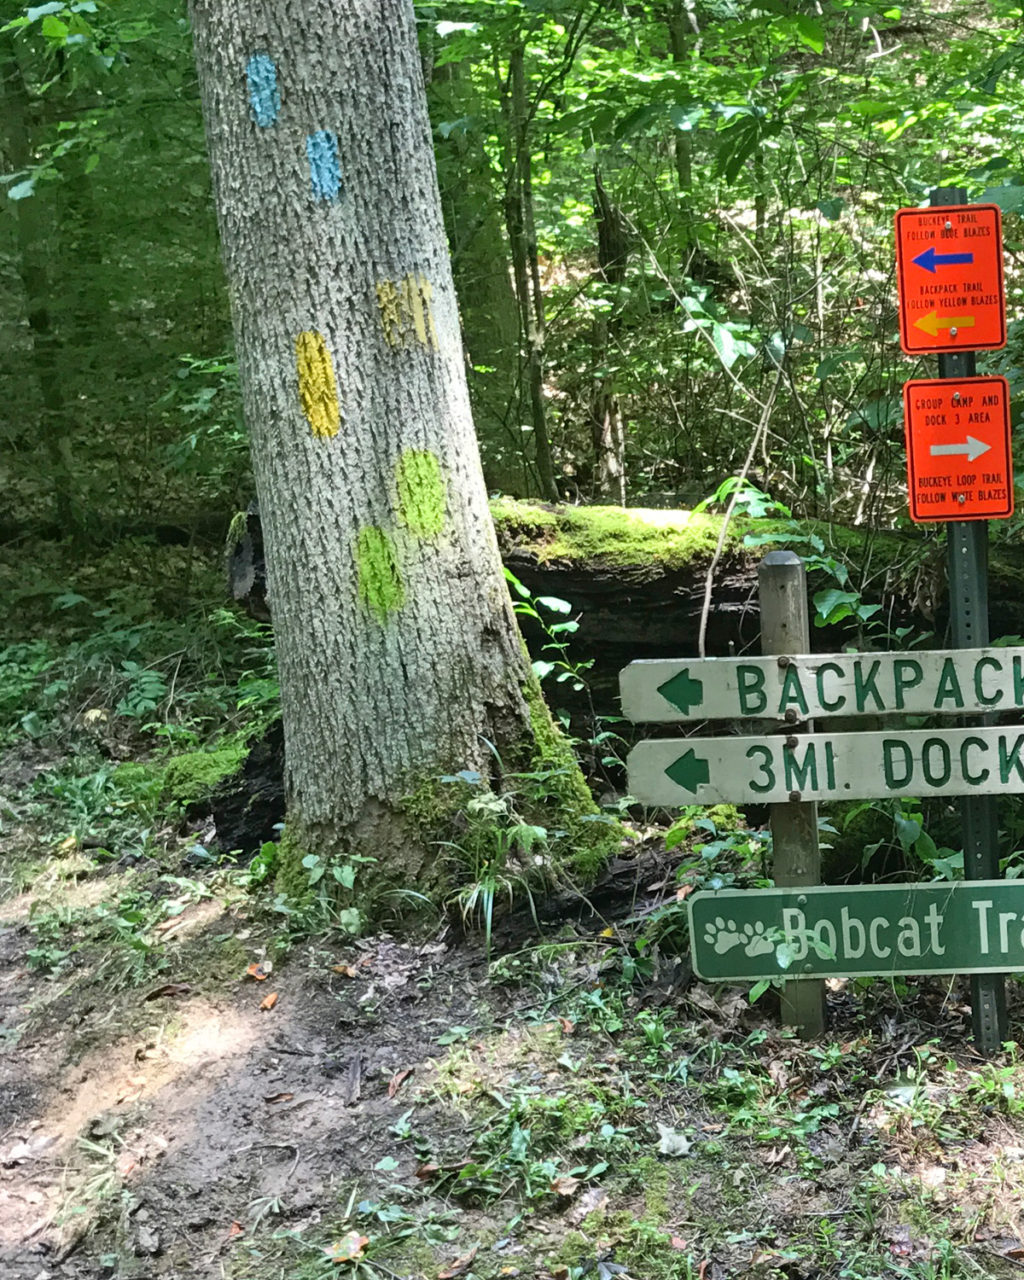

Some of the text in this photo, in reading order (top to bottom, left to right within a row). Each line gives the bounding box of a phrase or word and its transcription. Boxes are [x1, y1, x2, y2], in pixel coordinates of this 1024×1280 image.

[957, 214, 978, 224] TRAIL
[907, 230, 935, 241] FOLLOW
[964, 226, 991, 238] BLAZES
[920, 282, 983, 296] BACKPACK TRAIL
[907, 295, 998, 310] FOLLOW YELLOW BLAZES
[915, 395, 999, 411] GROUP CAMP AND
[925, 412, 991, 426] DOCK 3 AREA
[919, 473, 1003, 488] BUCKEYE LOOP TRAIL
[917, 492, 946, 505] FOLLOW
[978, 488, 1006, 501] BLAZES
[748, 742, 852, 793] 3MI.
[783, 894, 946, 962] Bobcat
